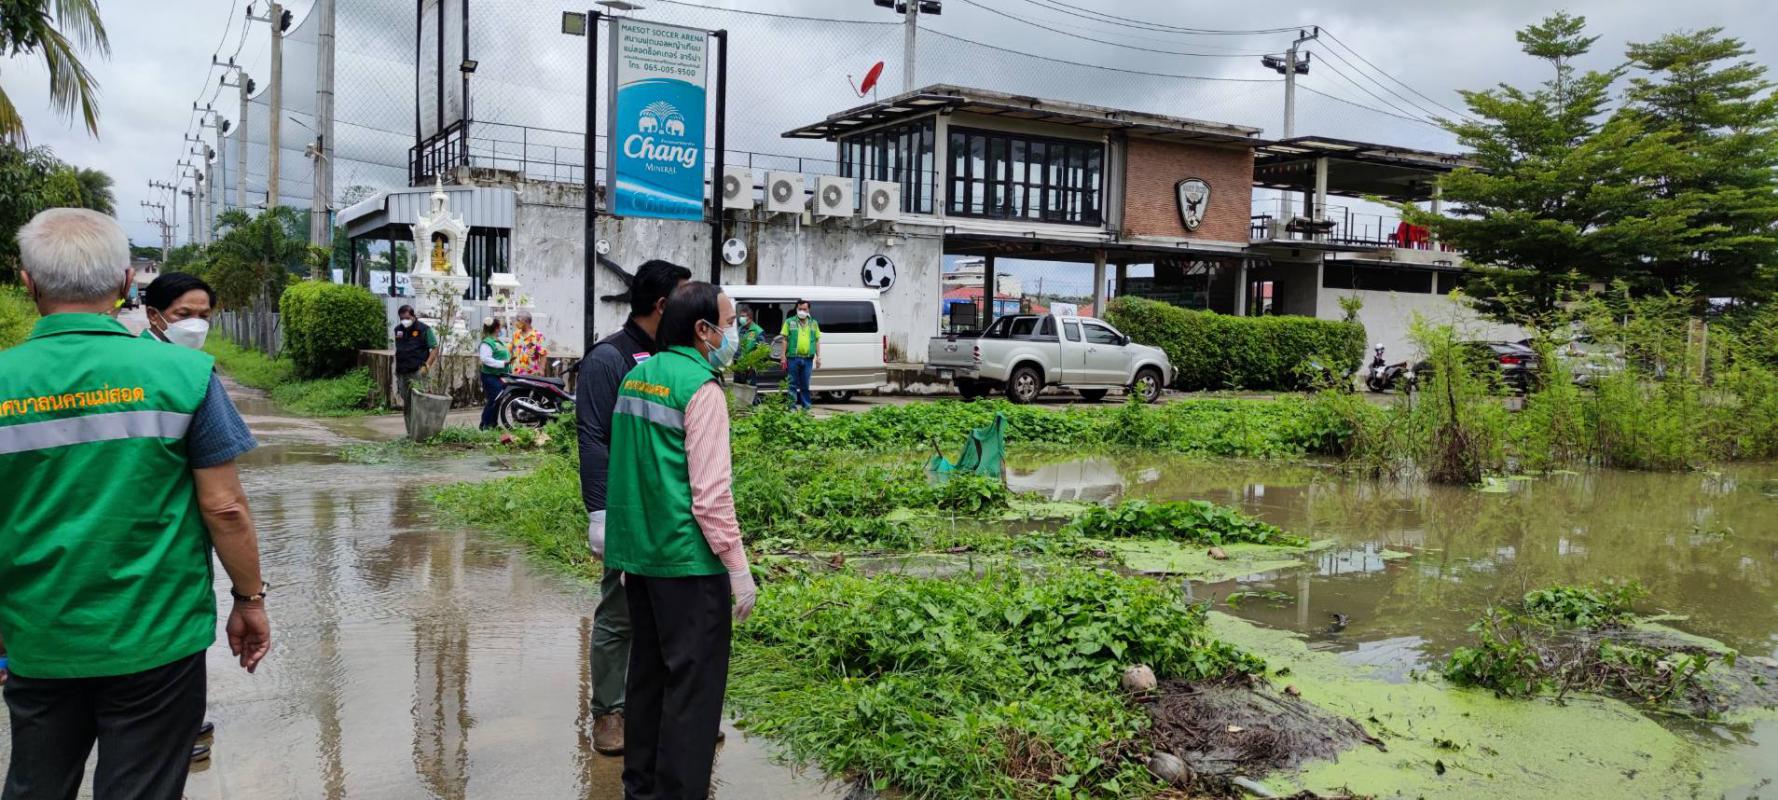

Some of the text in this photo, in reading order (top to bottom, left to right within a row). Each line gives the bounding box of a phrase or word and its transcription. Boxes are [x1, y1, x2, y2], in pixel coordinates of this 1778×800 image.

[622, 25, 703, 42] MAESOT SOCCER ARENA
[624, 134, 698, 168] Chang
[0, 384, 145, 416] ศบาลนครแม่สอด
